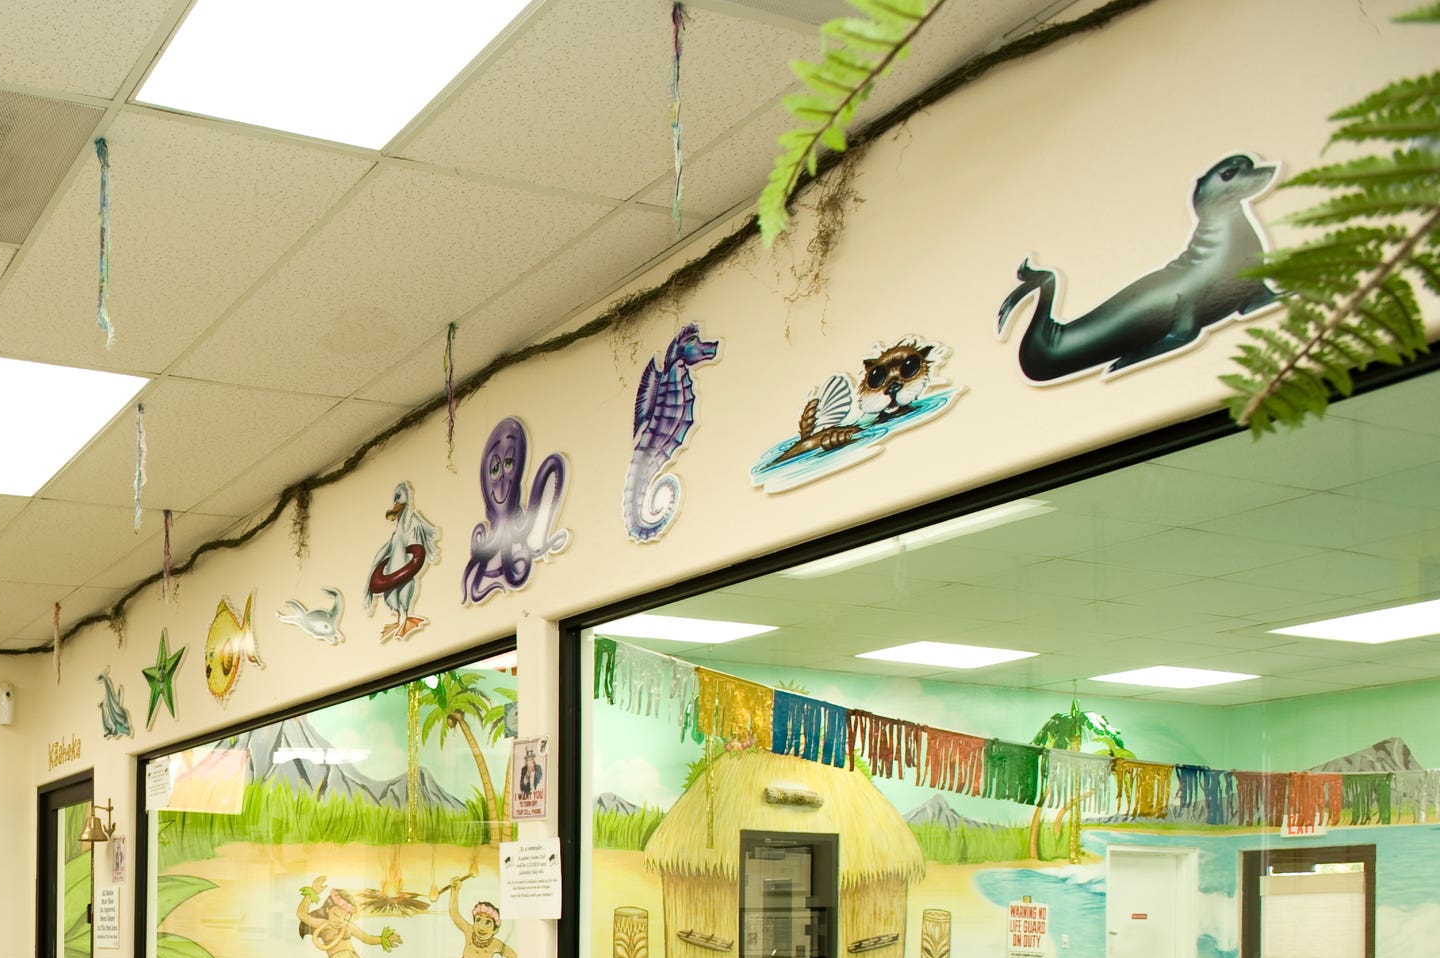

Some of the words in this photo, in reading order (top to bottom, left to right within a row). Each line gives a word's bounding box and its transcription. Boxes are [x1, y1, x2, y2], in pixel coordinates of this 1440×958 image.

[533, 791, 543, 800] YOU
[1010, 905, 1037, 919] WARNING
[1038, 907, 1046, 920] NO
[1010, 919, 1021, 932] LIFE
[1024, 920, 1045, 934] GUARD
[1013, 933, 1022, 947] ON
[1024, 934, 1040, 948] DUTY
